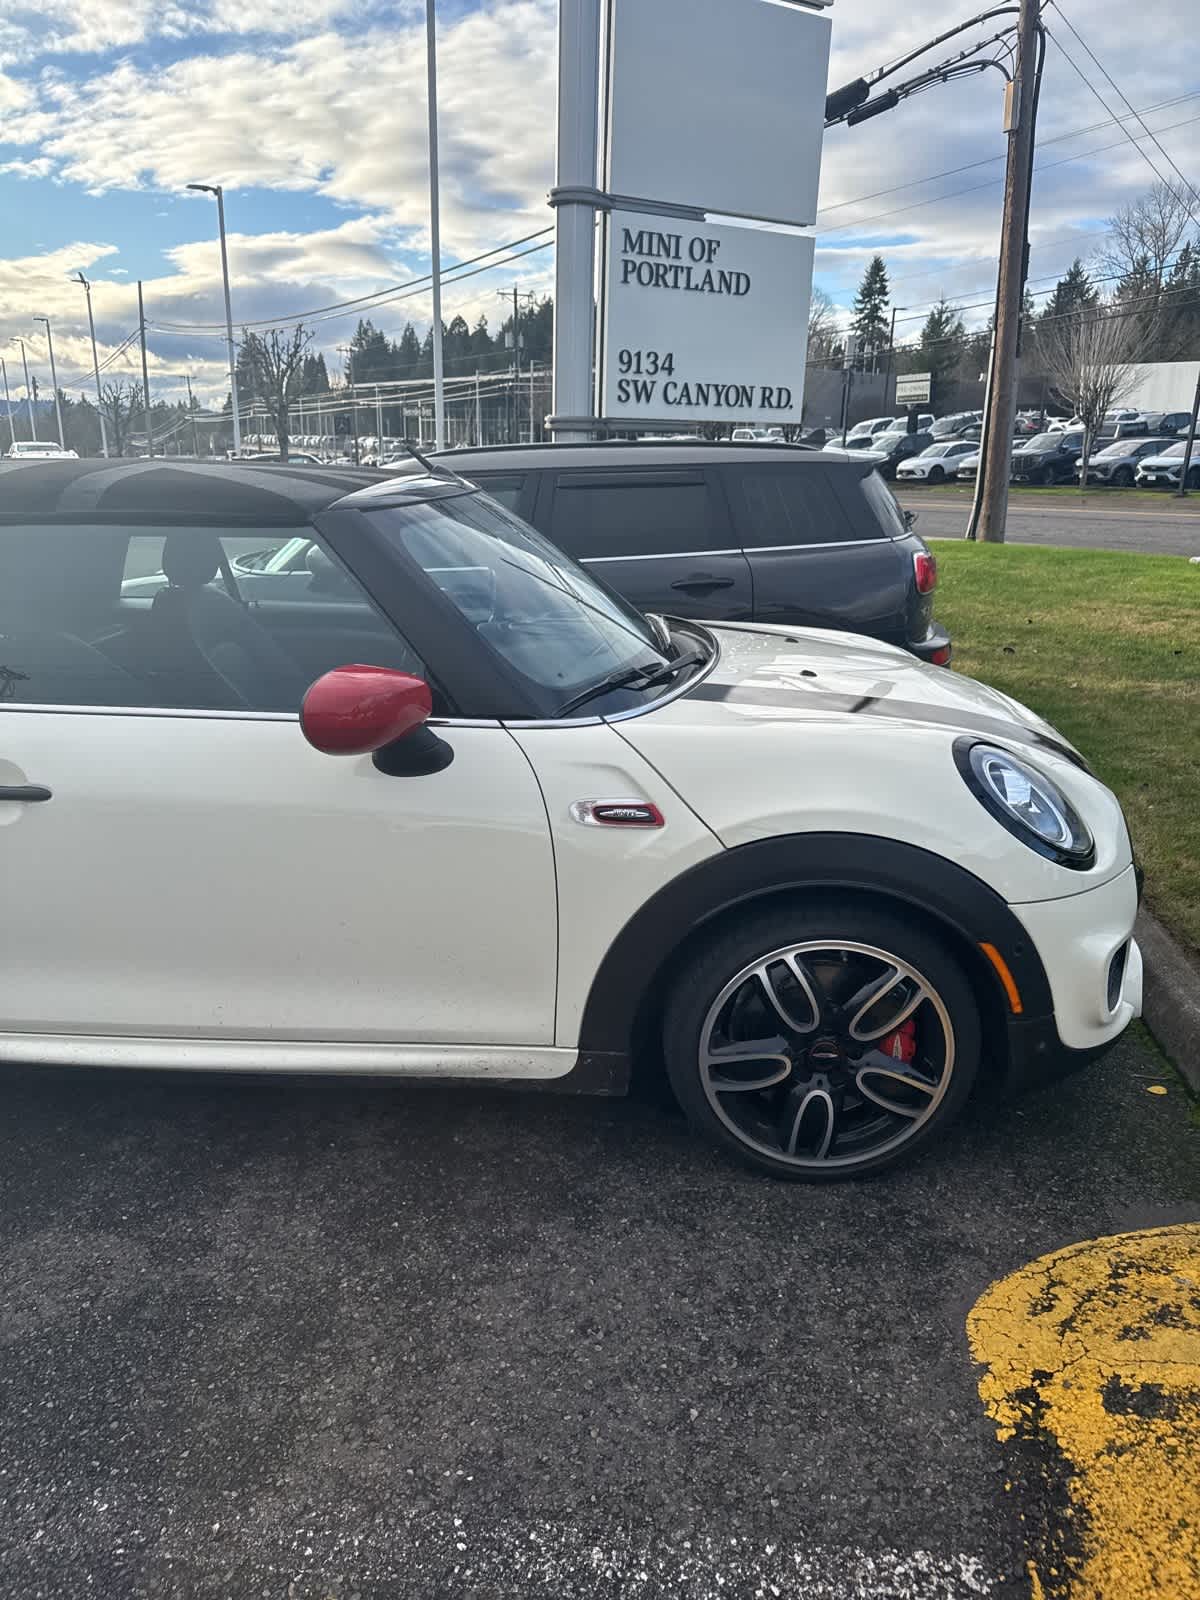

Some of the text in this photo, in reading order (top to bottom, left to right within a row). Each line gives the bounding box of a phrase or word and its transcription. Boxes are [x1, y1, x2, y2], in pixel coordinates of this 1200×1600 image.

[621, 228, 721, 263] MINI OF
[621, 259, 751, 296] PORTLAND
[618, 349, 675, 377] 9134
[617, 378, 794, 411] SW CANYON RD.
